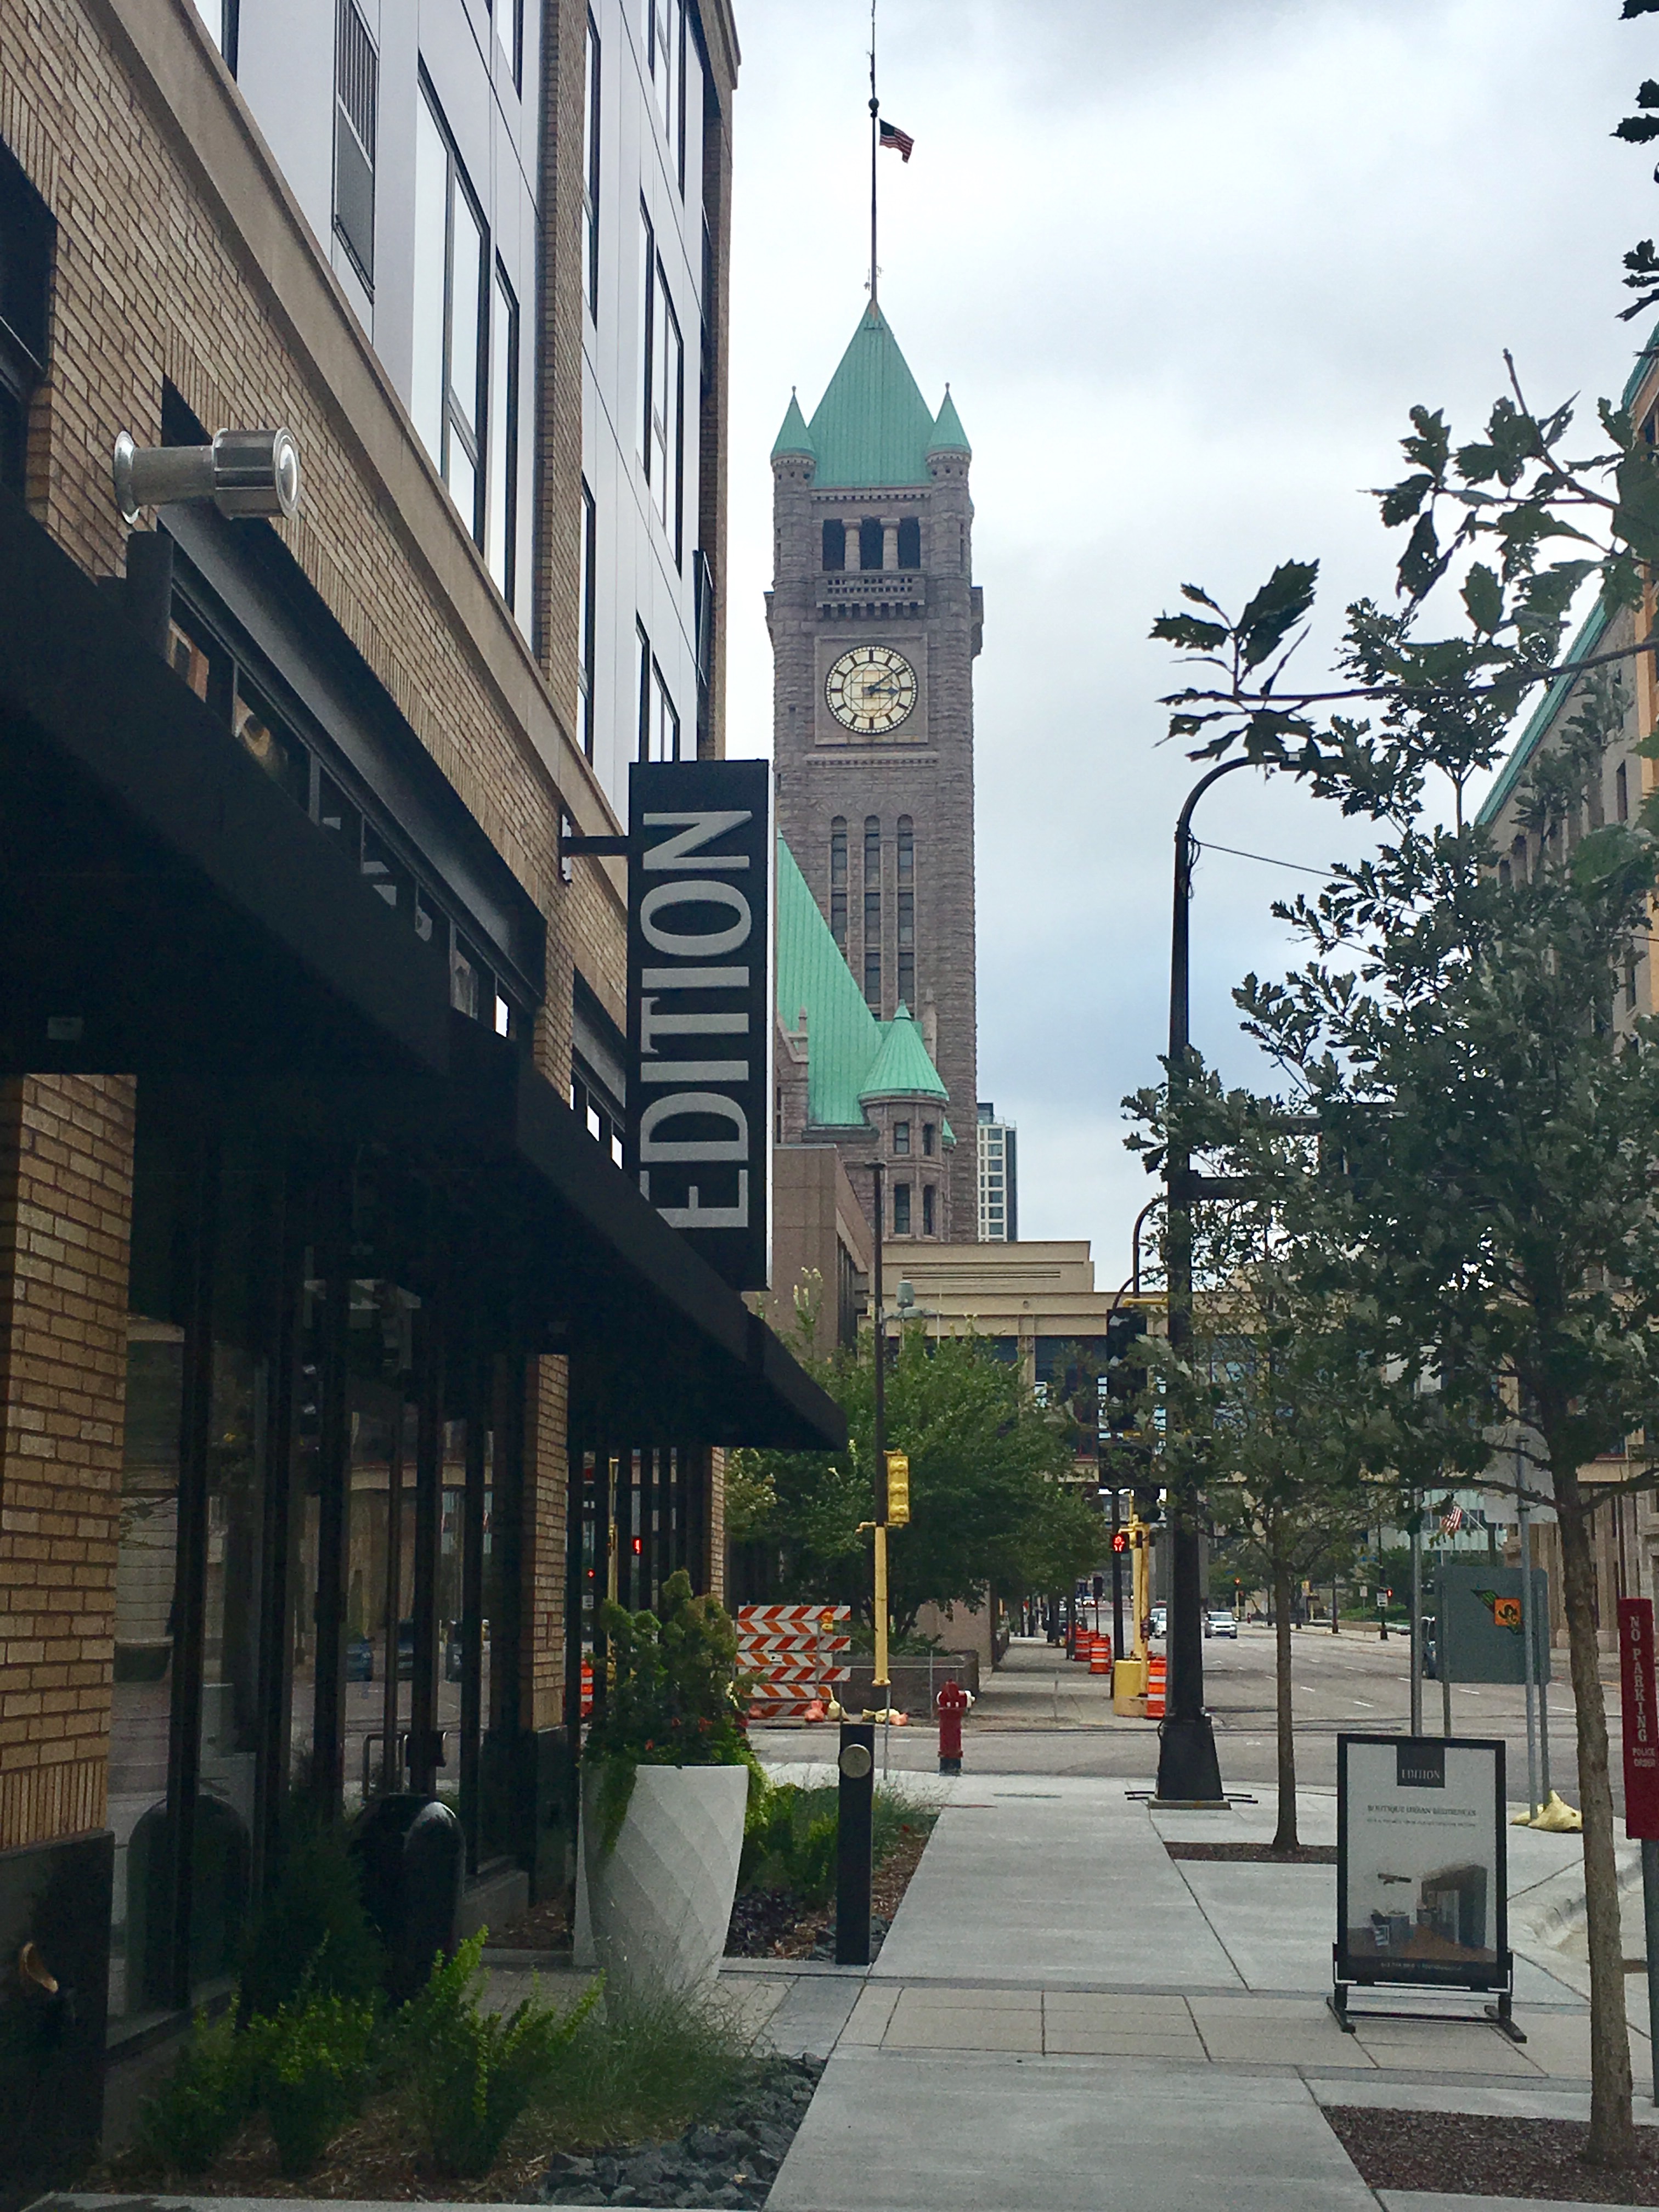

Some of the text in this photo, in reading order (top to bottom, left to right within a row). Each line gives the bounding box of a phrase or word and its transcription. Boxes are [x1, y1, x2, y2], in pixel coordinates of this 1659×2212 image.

[640, 810, 753, 1228] EDITION
[1629, 1615, 1647, 1742] NO PARKING
[1402, 1769, 1440, 1780] EDITION
[1632, 1747, 1655, 1756] POLICE
